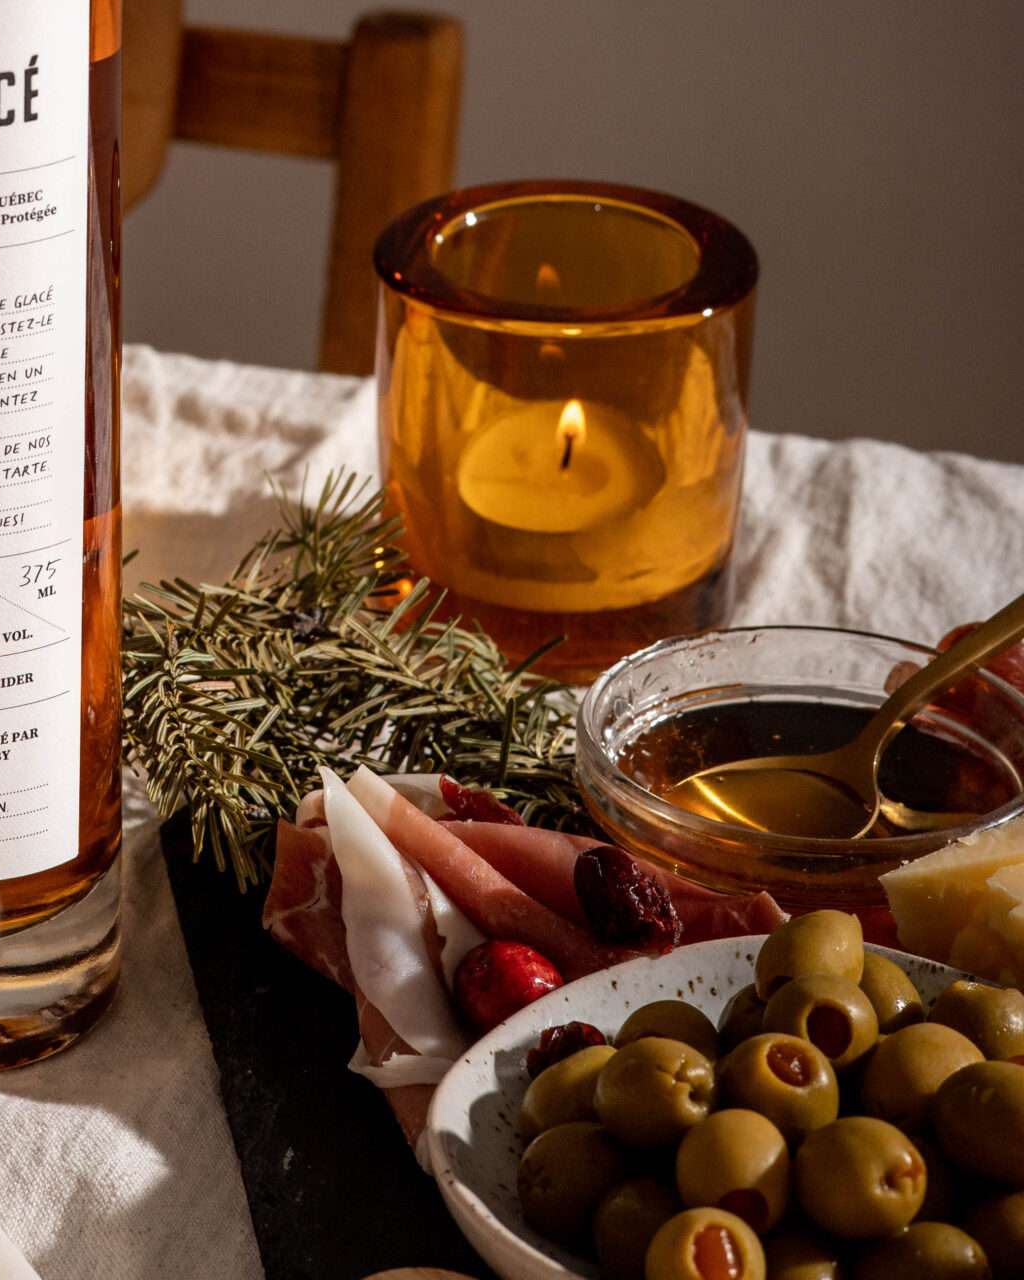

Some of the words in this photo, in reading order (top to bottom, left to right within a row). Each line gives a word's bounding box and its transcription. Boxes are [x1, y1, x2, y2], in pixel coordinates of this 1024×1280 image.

[1, 205, 57, 225] Protégée
[14, 284, 54, 309] GLACÉ
[25, 365, 43, 380] UN
[4, 442, 21, 456] DE
[28, 435, 51, 451] NOS
[2, 460, 48, 480] TARTE
[19, 558, 62, 587] 375
[37, 584, 56, 599] ML
[12, 728, 39, 743] PAR
